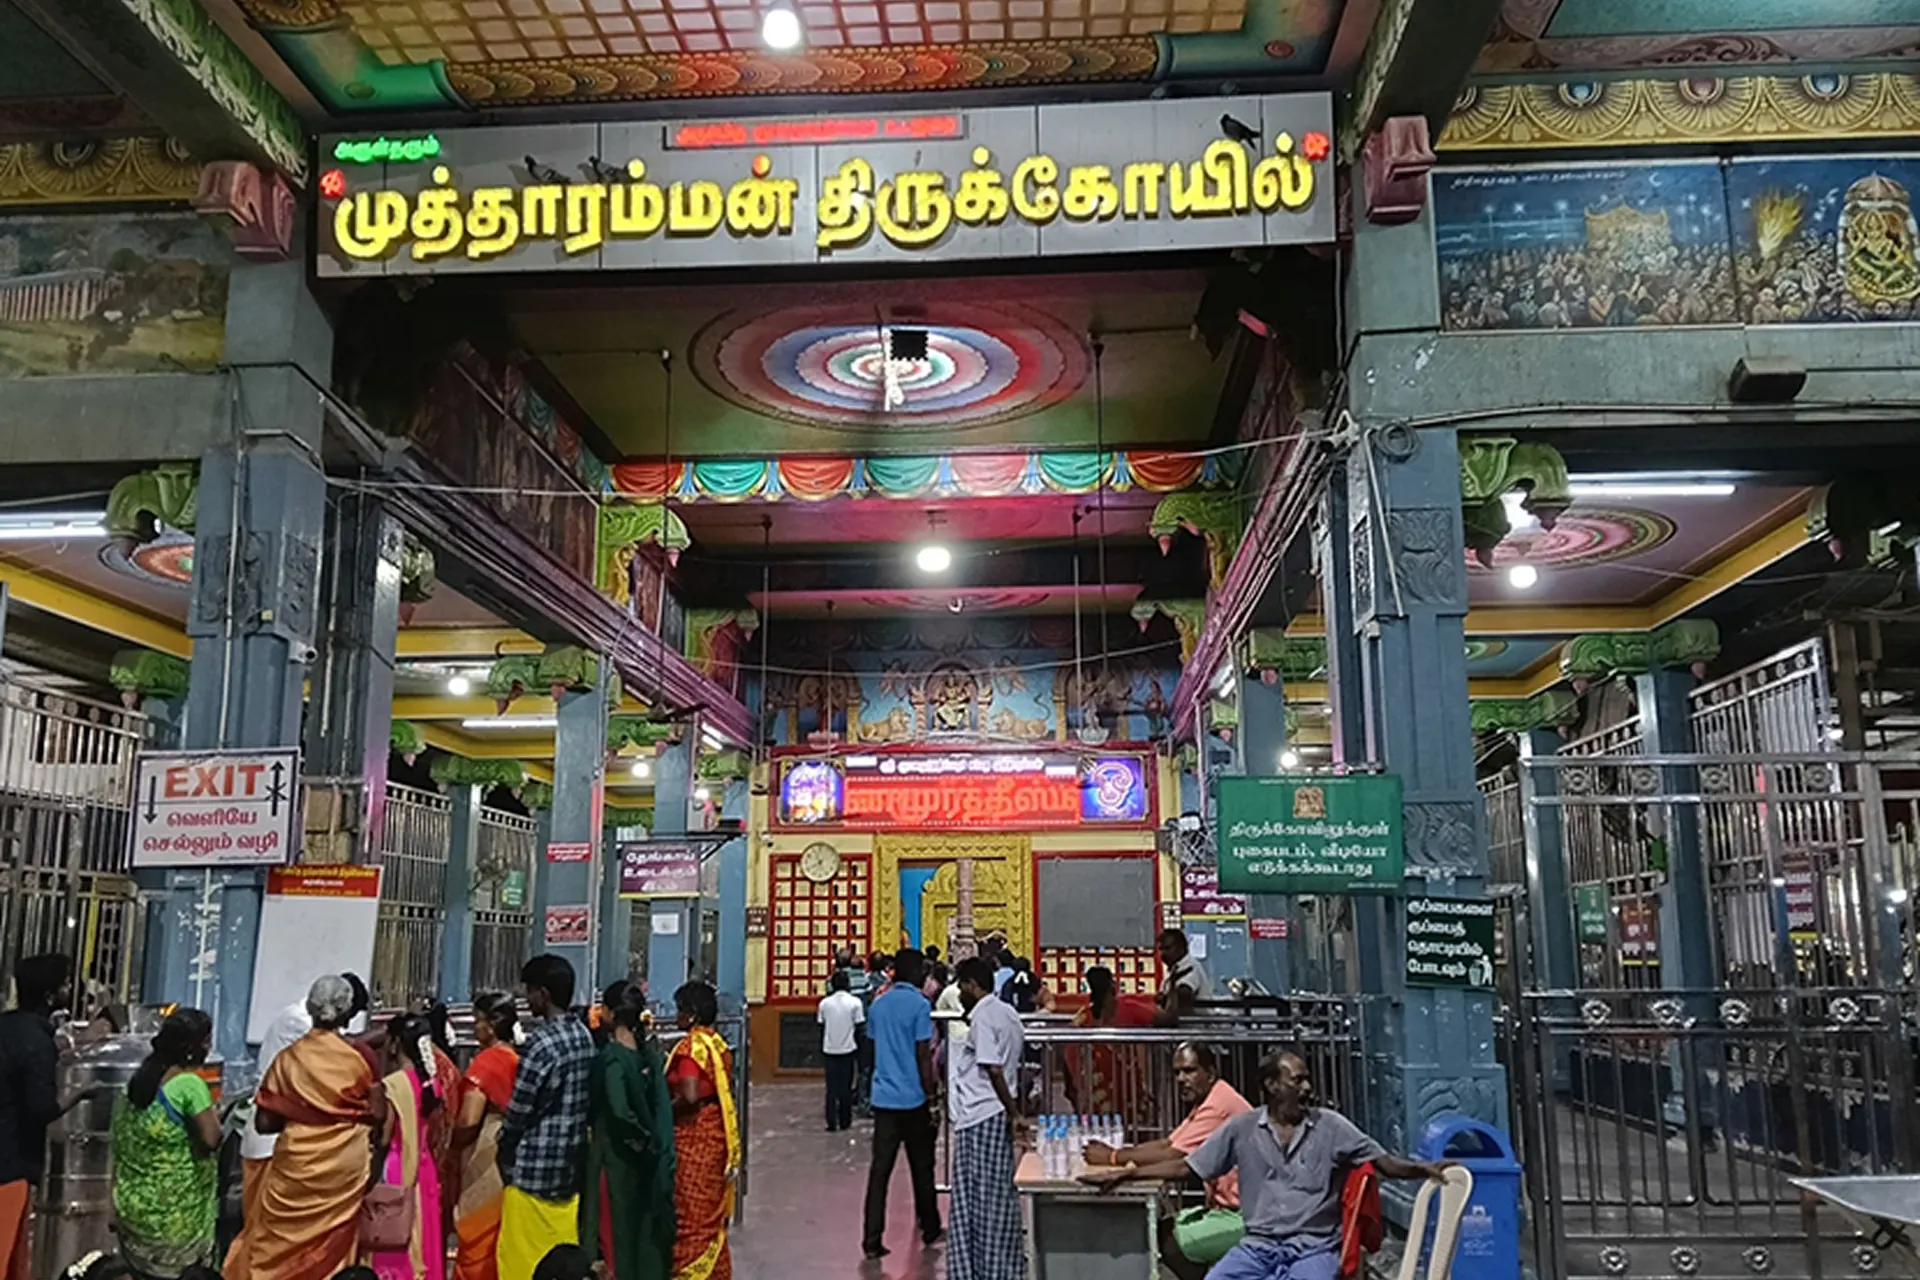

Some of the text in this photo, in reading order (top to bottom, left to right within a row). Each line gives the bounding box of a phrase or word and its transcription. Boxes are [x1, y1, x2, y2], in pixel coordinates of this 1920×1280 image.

[333, 132, 1314, 260] முத்தாரம்மன் திருக்கோயில்
[164, 764, 265, 798] EXIT
[166, 807, 257, 828] வெளியே
[143, 829, 278, 857] செல்லும் வழி
[1321, 842, 1387, 859] வீடியோ
[1408, 898, 1493, 915] குப்பைகளை
